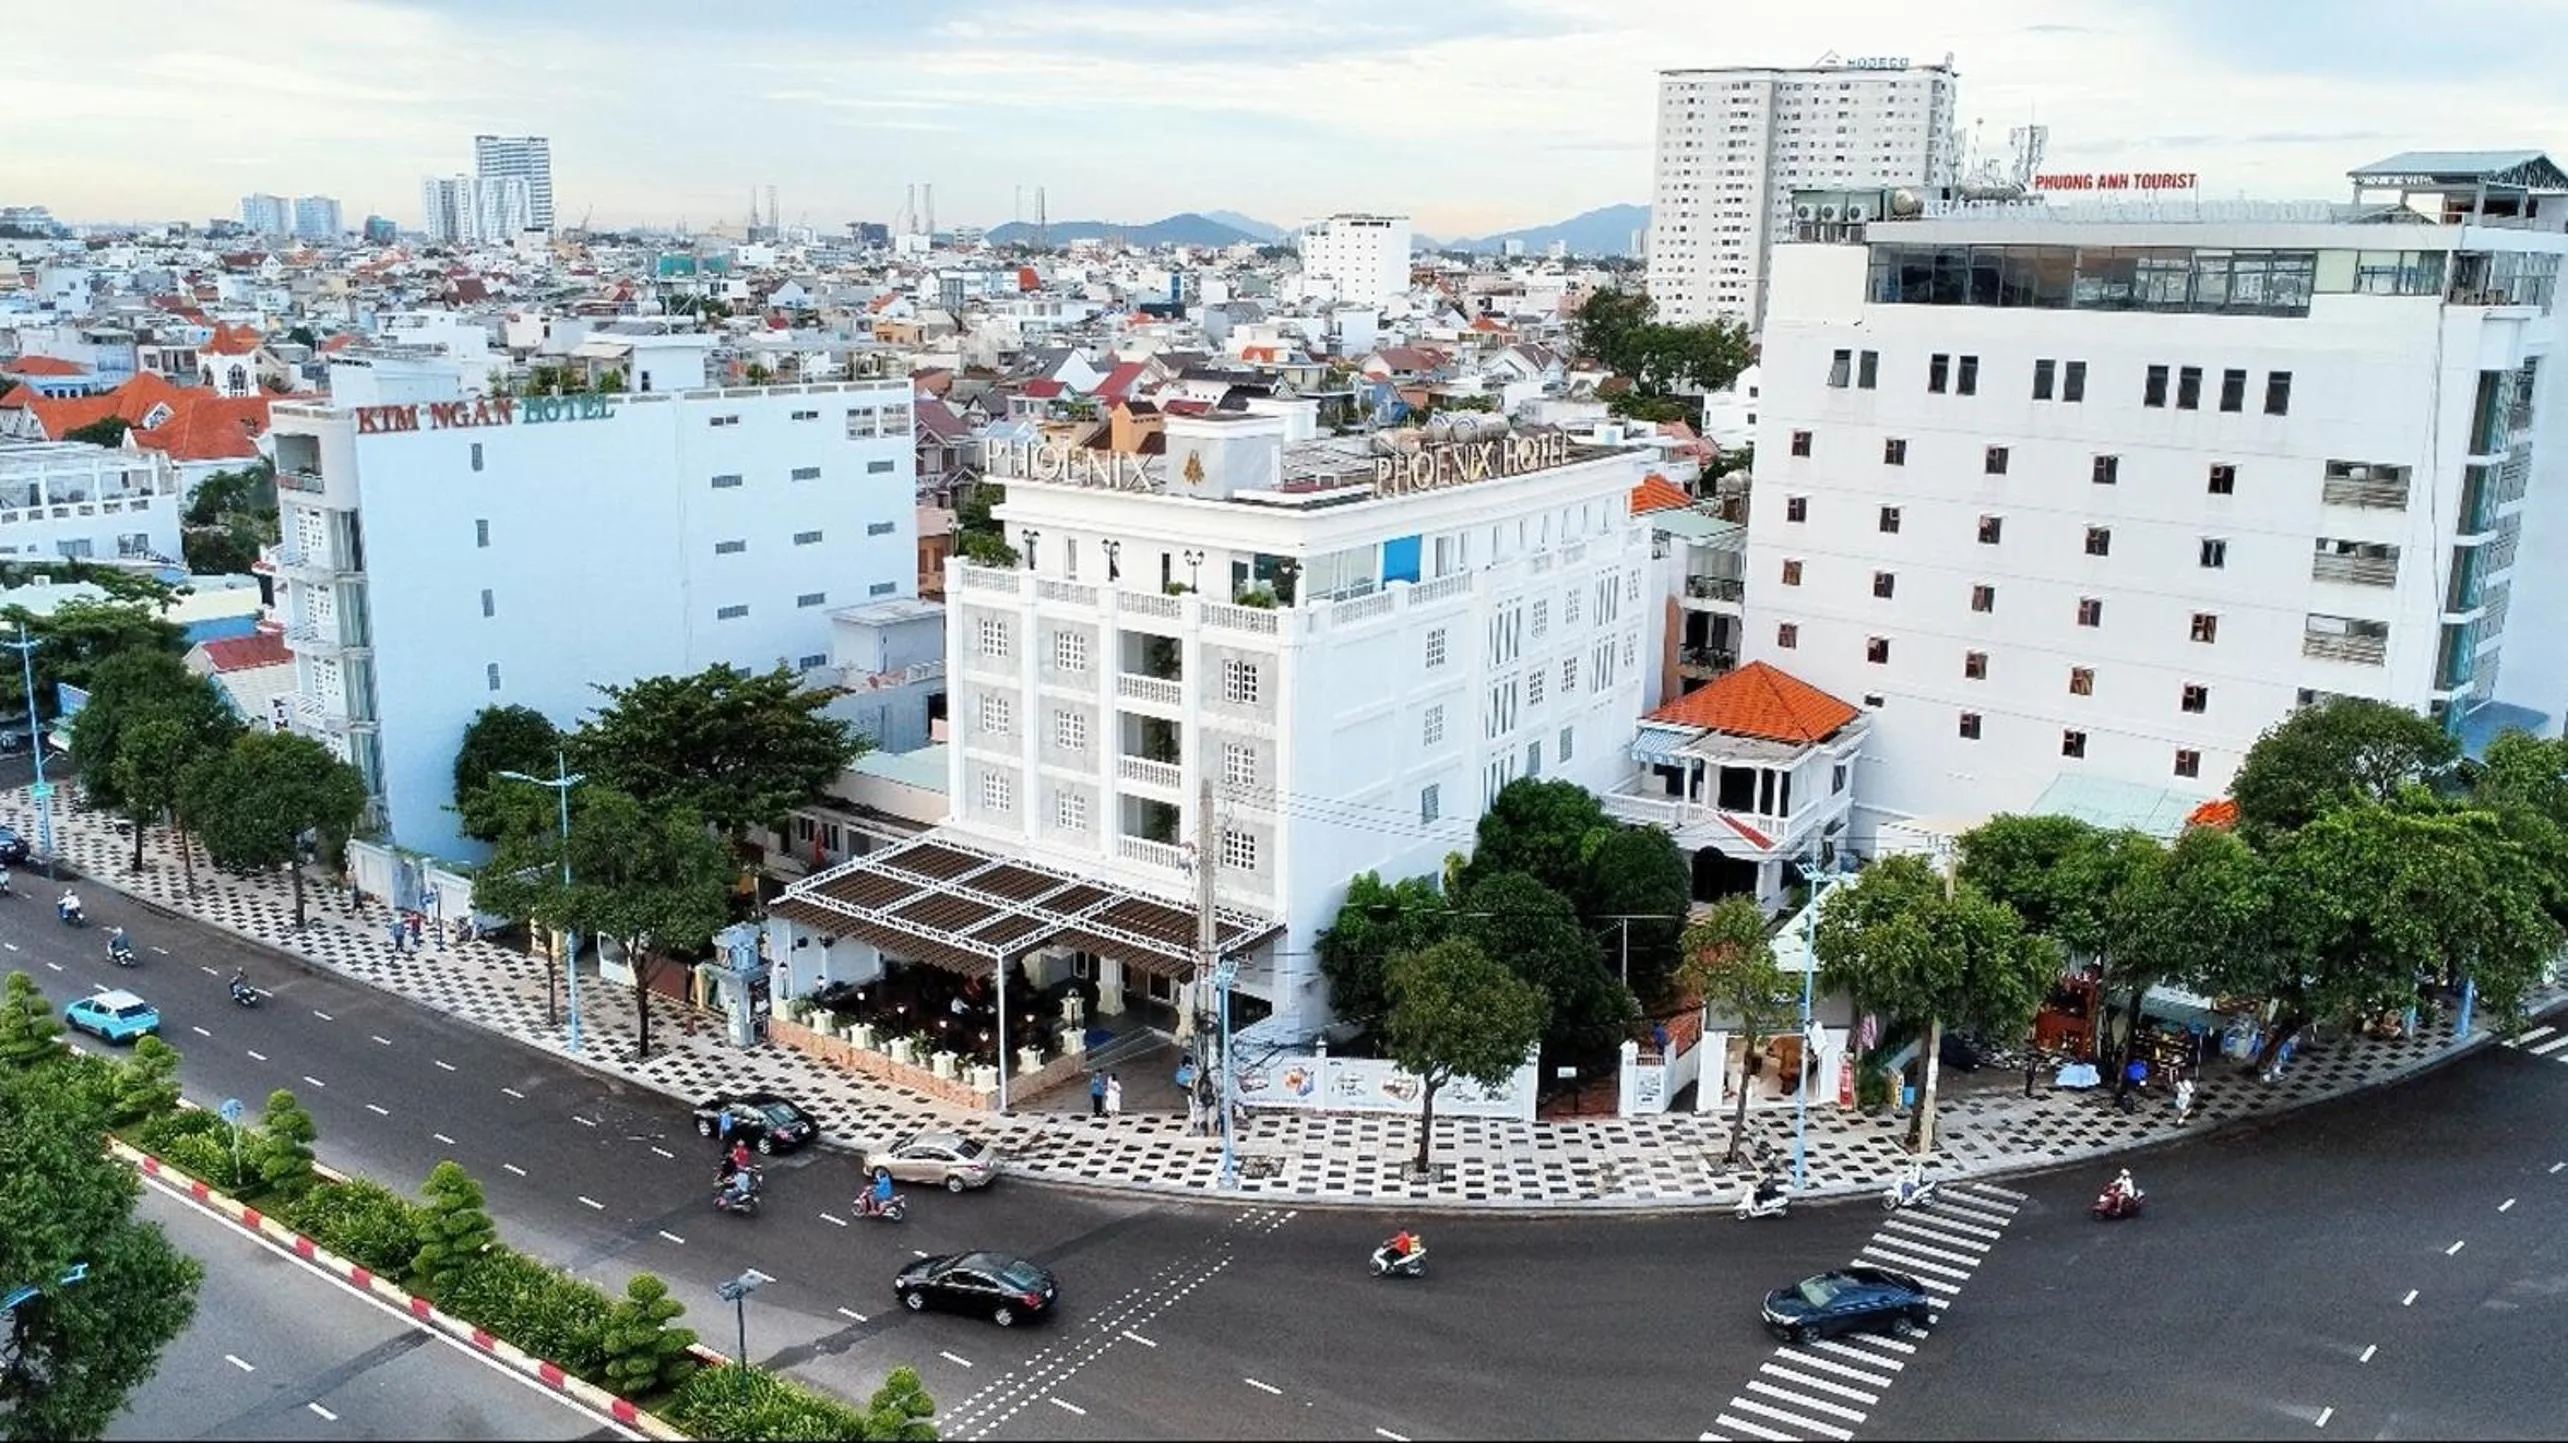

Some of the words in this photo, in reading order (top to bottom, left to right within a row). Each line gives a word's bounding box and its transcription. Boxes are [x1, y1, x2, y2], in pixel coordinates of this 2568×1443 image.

[2098, 173, 2129, 190] ANH
[2134, 172, 2197, 189] TOURIST
[355, 404, 419, 434] KIM
[522, 393, 616, 424] HOTEL
[984, 435, 1154, 492] PHOENIX
[1375, 440, 1494, 497] PHOENIX
[1502, 429, 1568, 474] HOTEL
